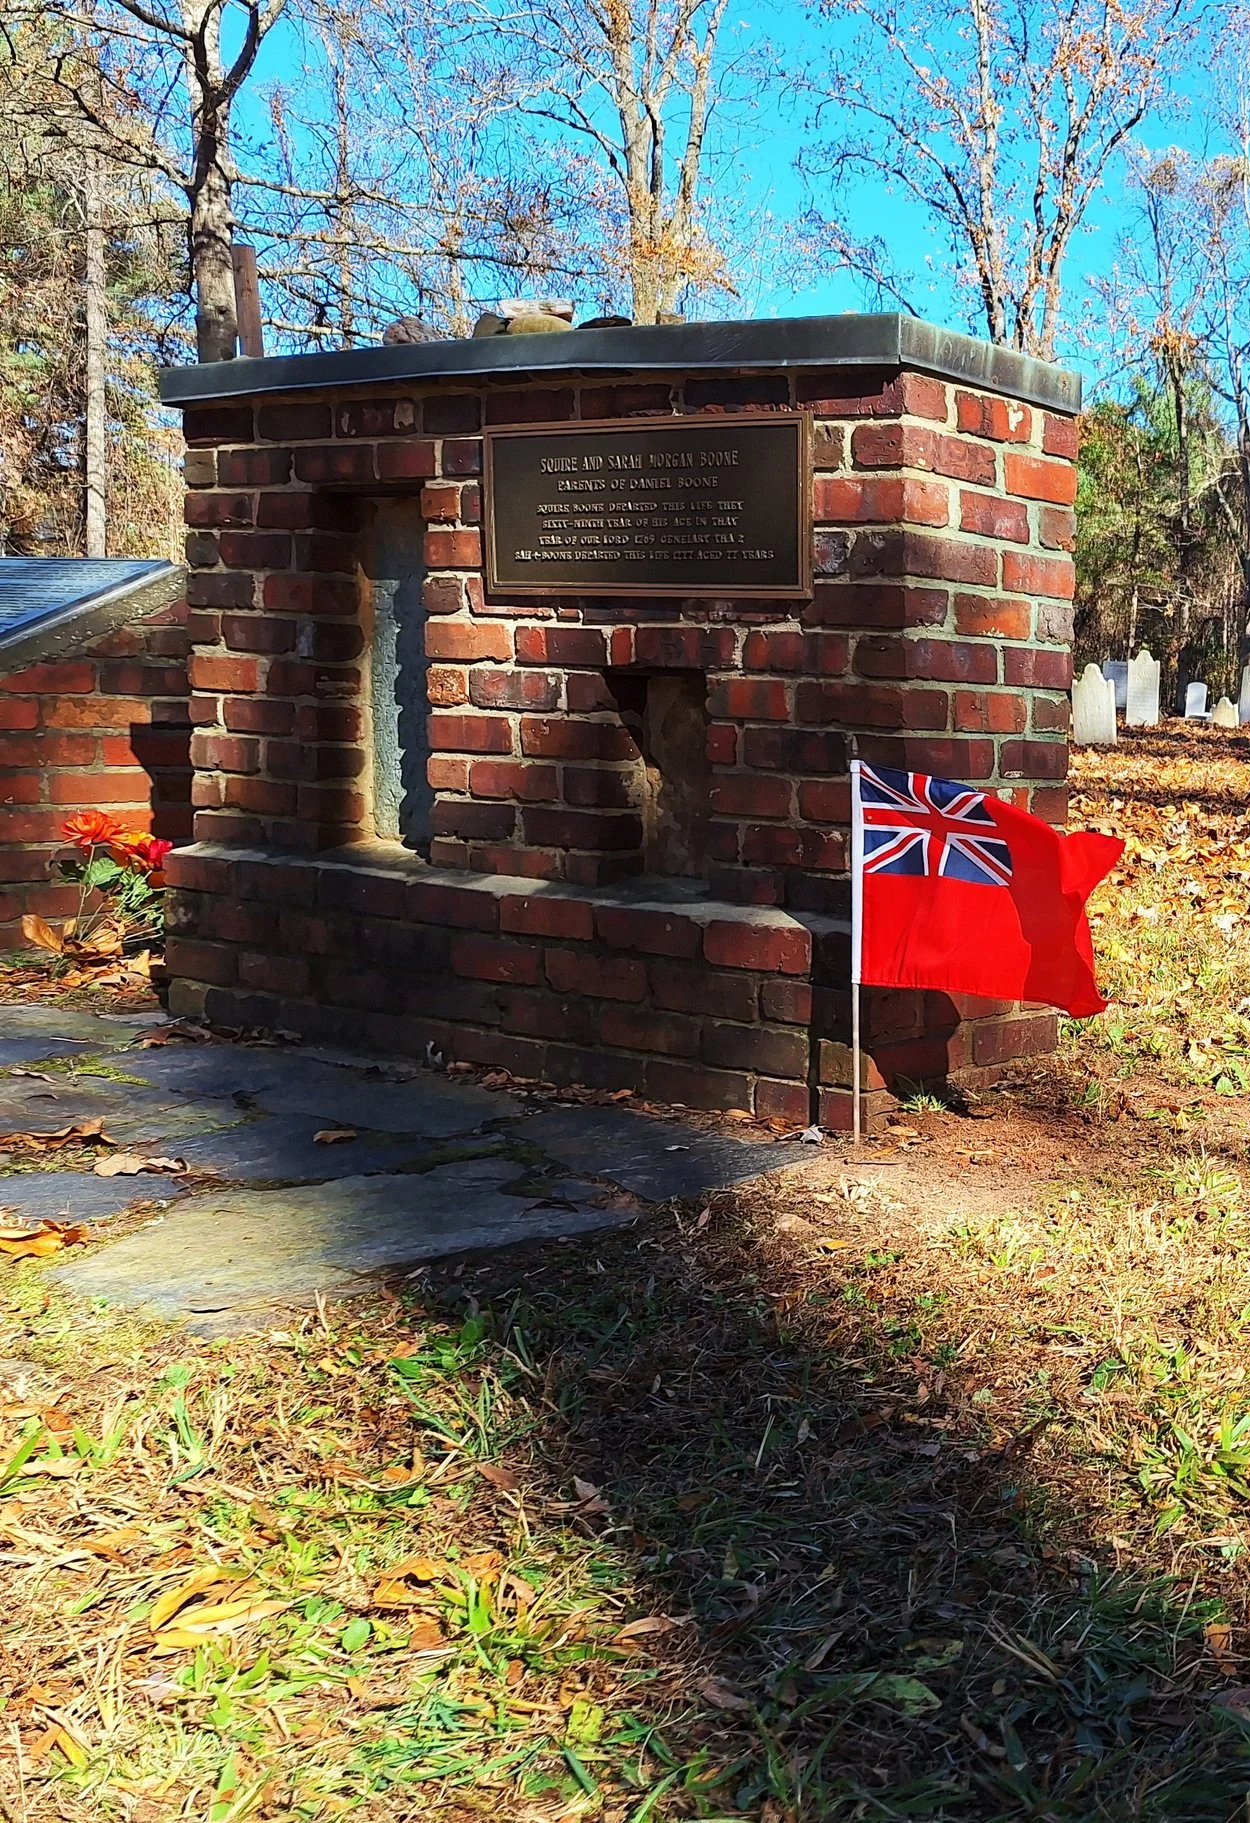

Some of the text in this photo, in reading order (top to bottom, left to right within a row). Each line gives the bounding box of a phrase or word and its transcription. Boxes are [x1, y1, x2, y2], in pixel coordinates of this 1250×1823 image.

[540, 450, 739, 474] SQUIRE AND SARAH MORGAN BOONE
[557, 476, 719, 492] PARENTS OF DANIEL BOONE
[536, 500, 744, 514] SQUIRE BOONE DEPARTED THIS LIFE THEY
[606, 517, 632, 528] YEAR
[635, 517, 649, 528] OF
[651, 517, 668, 527] HIS
[673, 516, 692, 527] AGE
[695, 516, 707, 526] IN
[538, 534, 563, 546] YEAR
[564, 535, 577, 545] OF
[580, 535, 601, 545] OUR
[603, 534, 630, 544] LORD
[737, 534, 745, 544] 2
[574, 549, 620, 560] DEPARTED
[623, 550, 646, 560] THIS
[649, 550, 669, 560] LIFE
[696, 549, 723, 560] AGED
[726, 550, 738, 560] 77
[741, 549, 775, 560] YEARS
